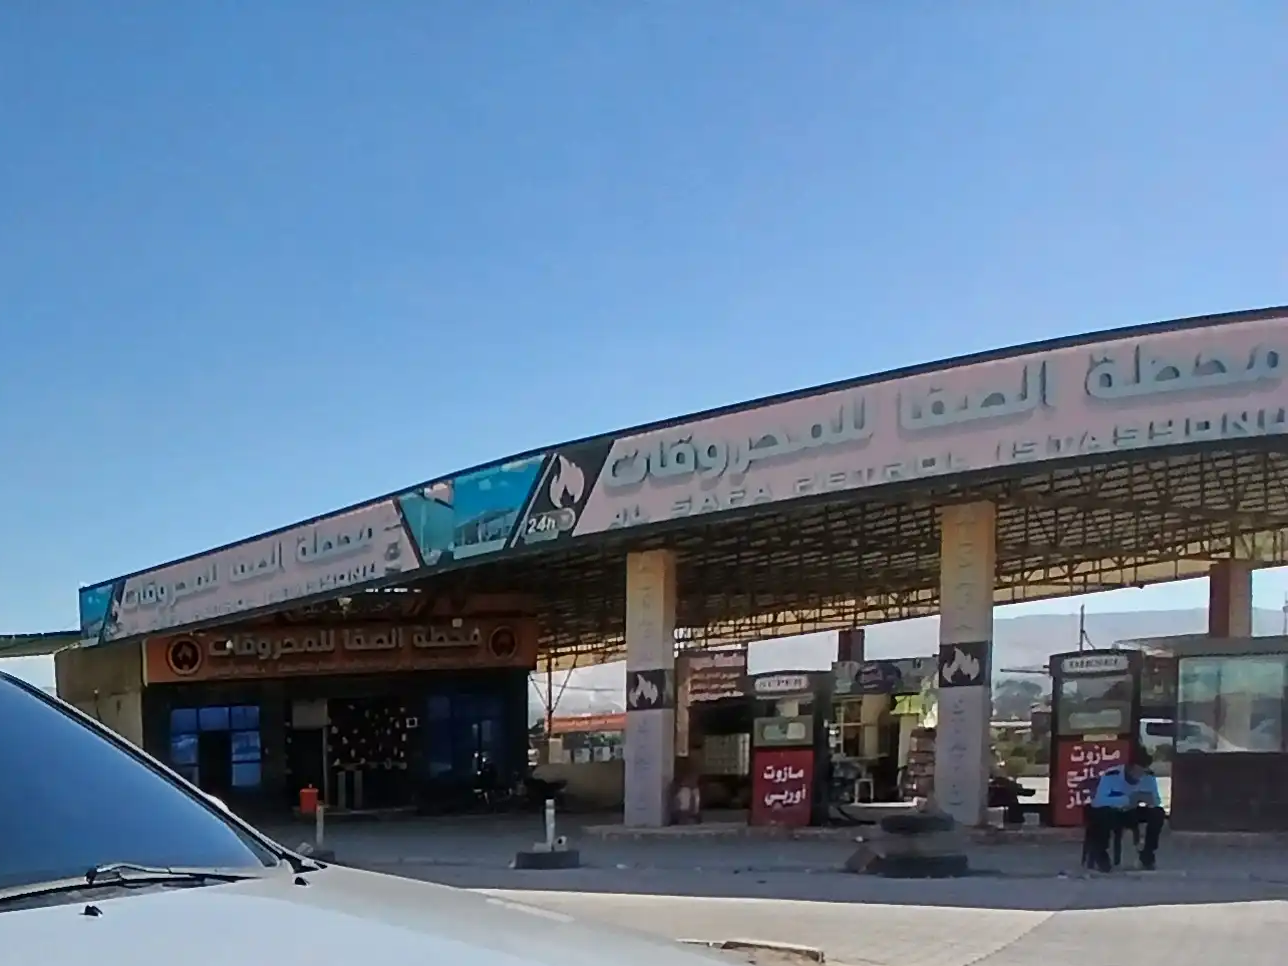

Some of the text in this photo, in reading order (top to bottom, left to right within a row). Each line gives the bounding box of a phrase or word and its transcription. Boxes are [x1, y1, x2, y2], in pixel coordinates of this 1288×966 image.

[608, 343, 1286, 478] محطة الصفا للمحروقات
[792, 449, 970, 498] PETROL
[527, 515, 556, 535] 24h
[295, 528, 373, 564] محطة
[227, 541, 286, 584] الصفا
[343, 627, 404, 651] الصفا
[412, 625, 482, 649] محطة
[1070, 744, 1120, 766] مازوت
[763, 765, 804, 783] مازوت
